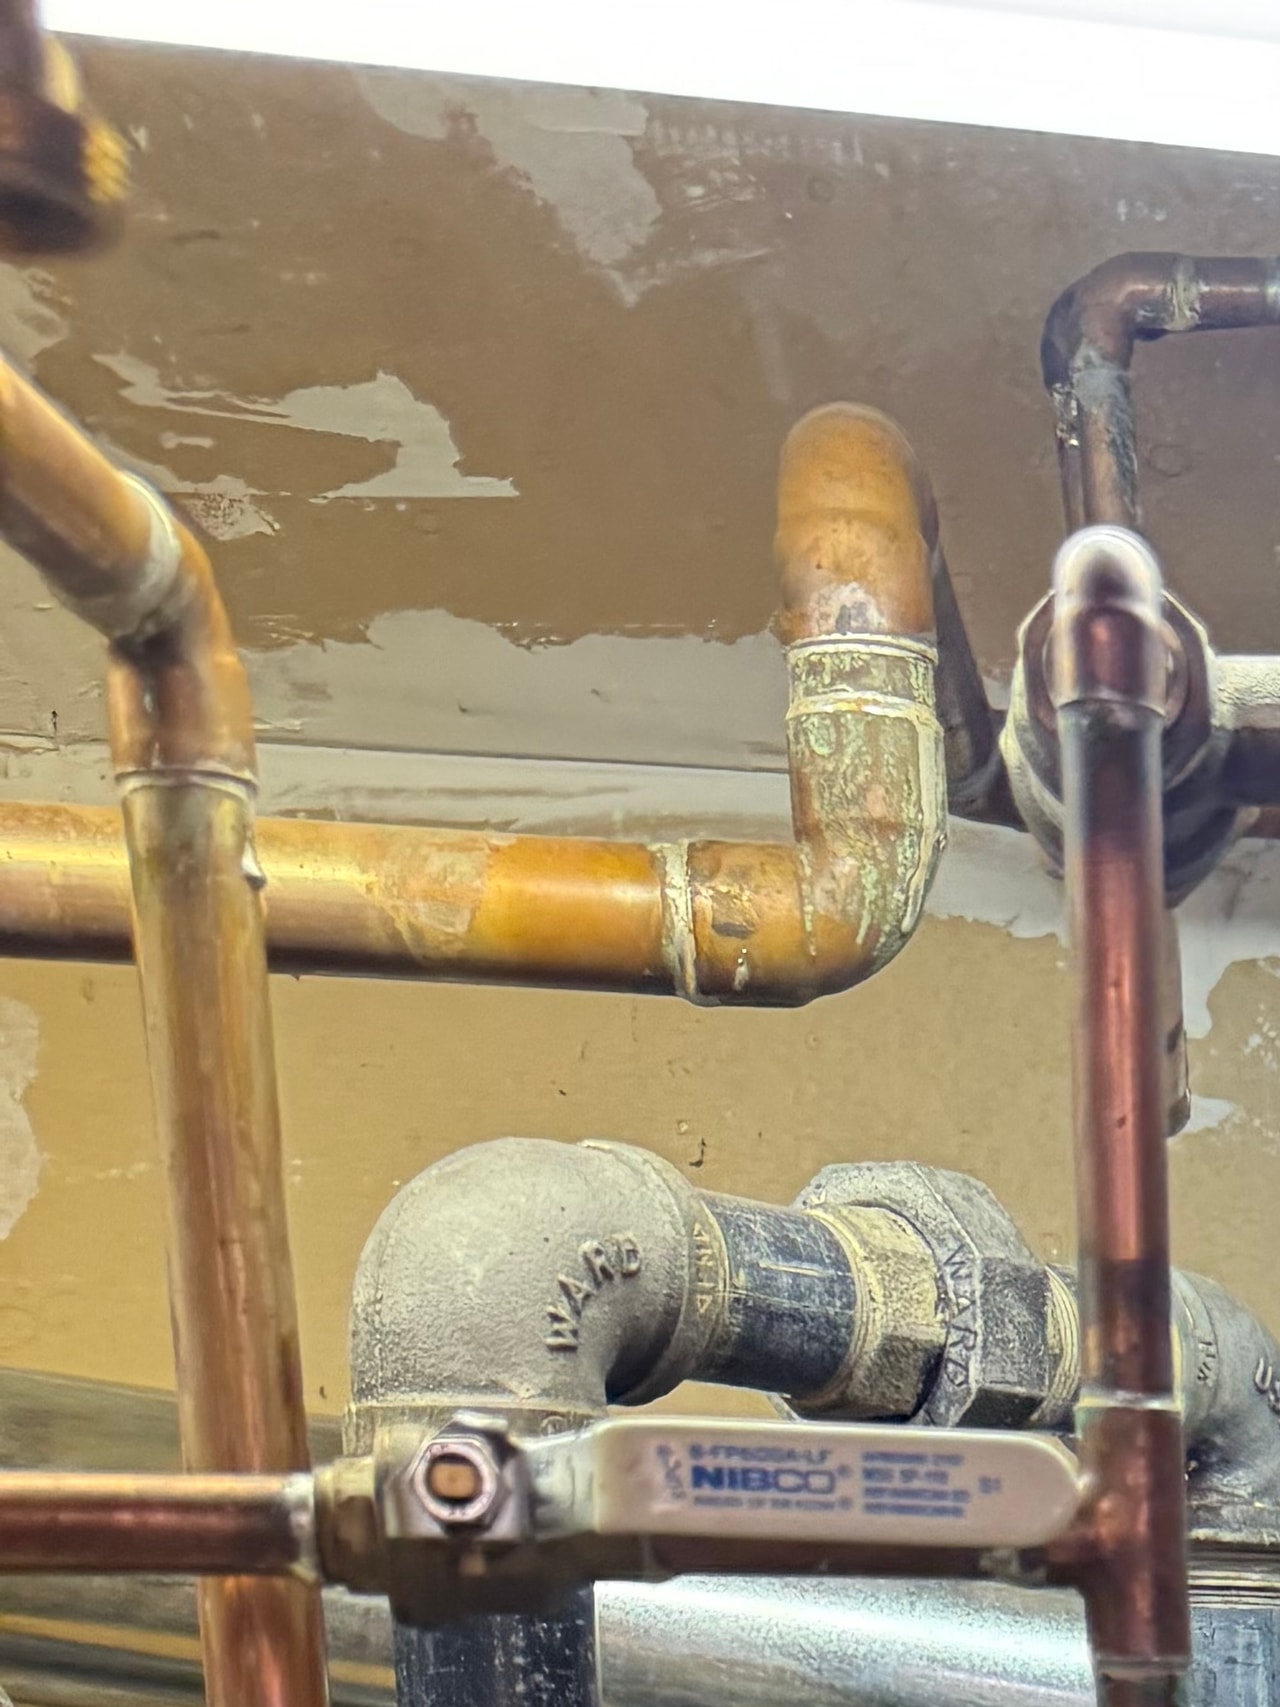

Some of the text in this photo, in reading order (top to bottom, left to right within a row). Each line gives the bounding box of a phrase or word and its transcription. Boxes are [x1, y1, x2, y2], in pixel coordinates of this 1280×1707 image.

[543, 1231, 642, 1352] WARD
[943, 1243, 977, 1388] WARD
[691, 1465, 837, 1495] NIBCO
